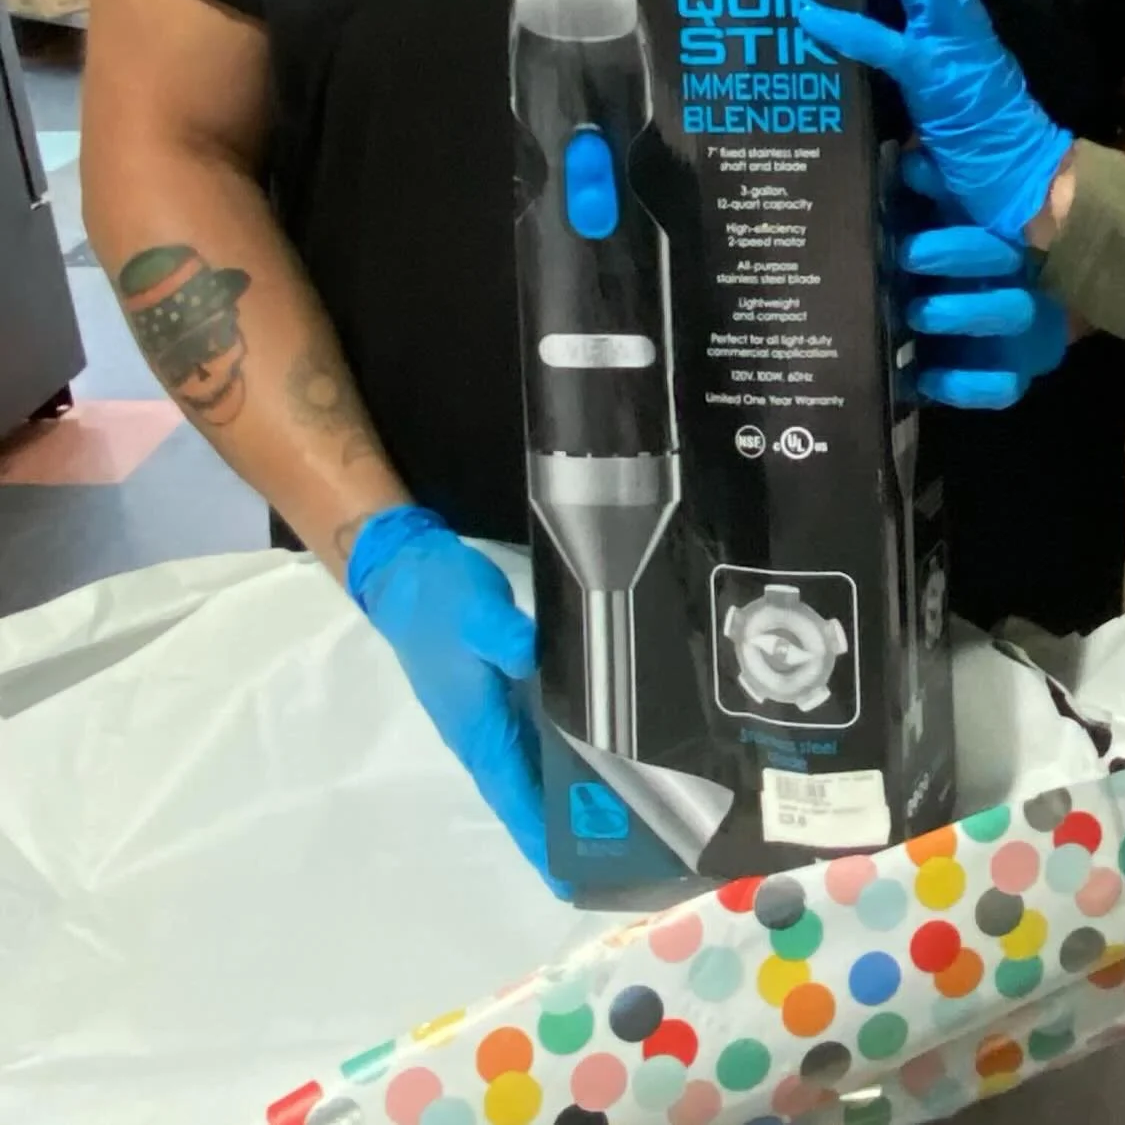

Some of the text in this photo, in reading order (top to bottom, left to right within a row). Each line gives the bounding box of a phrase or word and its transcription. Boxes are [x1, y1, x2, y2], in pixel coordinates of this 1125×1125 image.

[682, 72, 841, 101] IMMERSION
[683, 104, 844, 134] BLENDER
[719, 147, 746, 159] fixed
[748, 147, 792, 159] stainless
[794, 147, 820, 159] steel
[720, 160, 807, 172] shaft and blade
[717, 198, 813, 211] 12-quart capacity
[726, 222, 806, 236] High-efficiency
[727, 236, 806, 248] 2-speed motor
[736, 260, 799, 272] All-purpose
[716, 273, 821, 285] stainless steel blade
[738, 297, 800, 311] Lightweight
[732, 311, 807, 323] and compact
[710, 332, 832, 348] Perfect for all light-duty
[706, 348, 839, 360] commercial applications
[705, 392, 845, 409] Limited One Year Warranty
